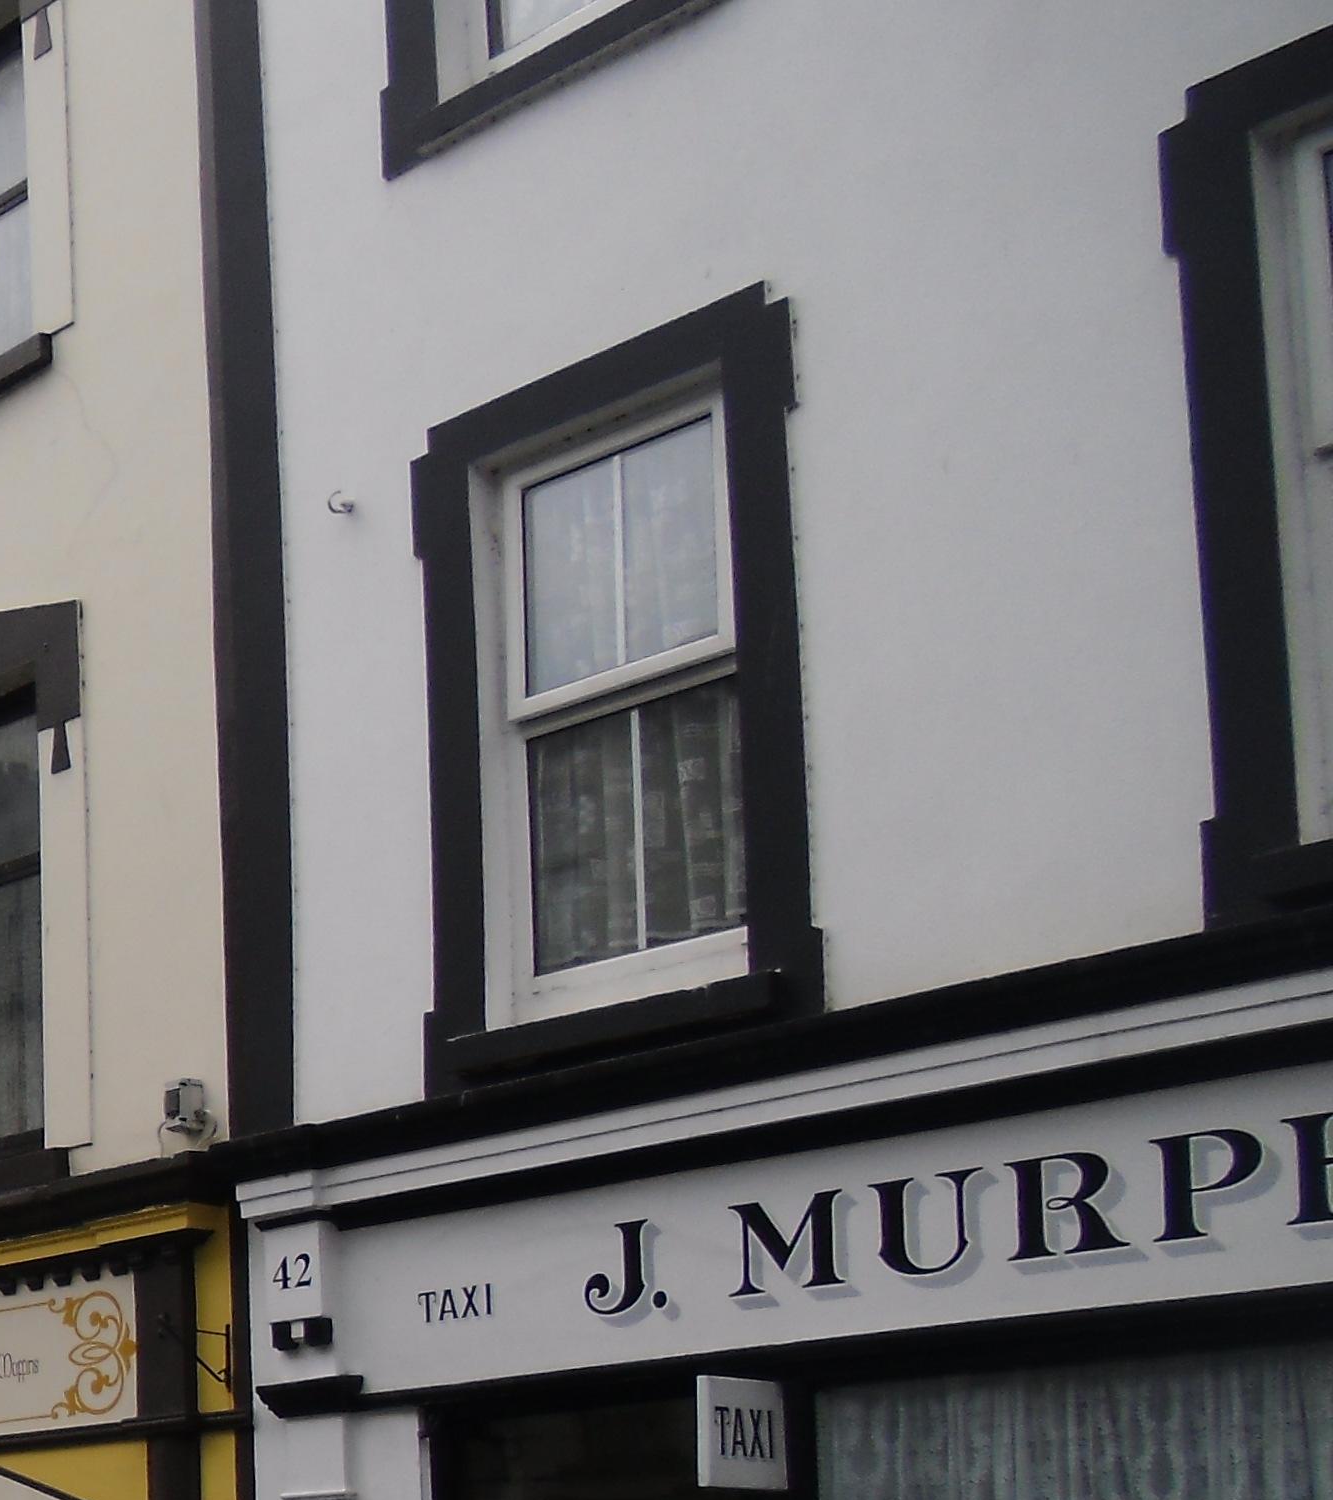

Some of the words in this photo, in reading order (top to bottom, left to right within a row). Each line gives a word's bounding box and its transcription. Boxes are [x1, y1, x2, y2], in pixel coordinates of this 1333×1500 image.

[271, 1252, 313, 1290] 42
[583, 1217, 670, 1316] J.
[417, 1282, 494, 1324] TAXI
[714, 1405, 776, 1462] TAXI
